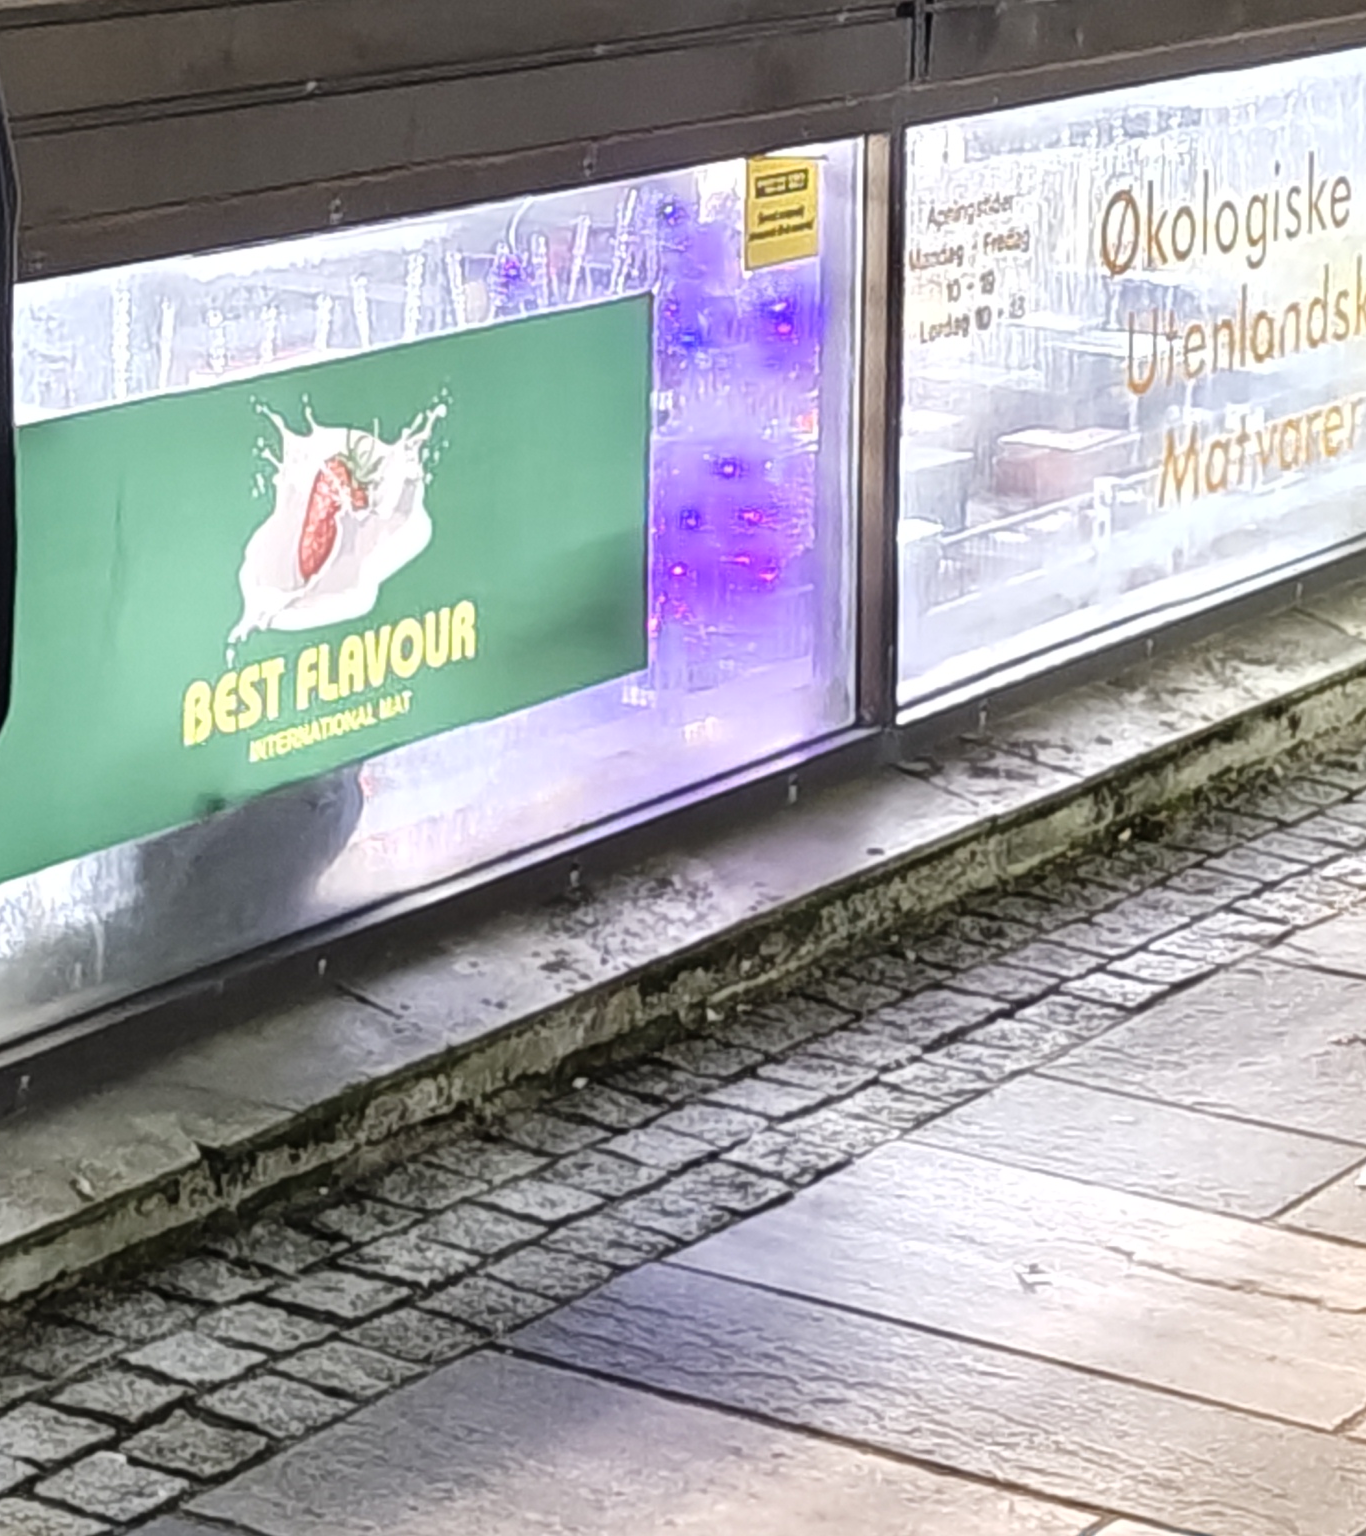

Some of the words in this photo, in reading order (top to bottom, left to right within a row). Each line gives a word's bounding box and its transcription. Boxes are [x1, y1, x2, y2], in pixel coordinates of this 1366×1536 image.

[1100, 150, 1352, 276] Økologiske
[1158, 397, 1365, 508] Matvarer
[183, 657, 285, 746] BEST
[295, 600, 476, 711] FLAVOUR
[248, 702, 377, 763] INTERNATIONAL
